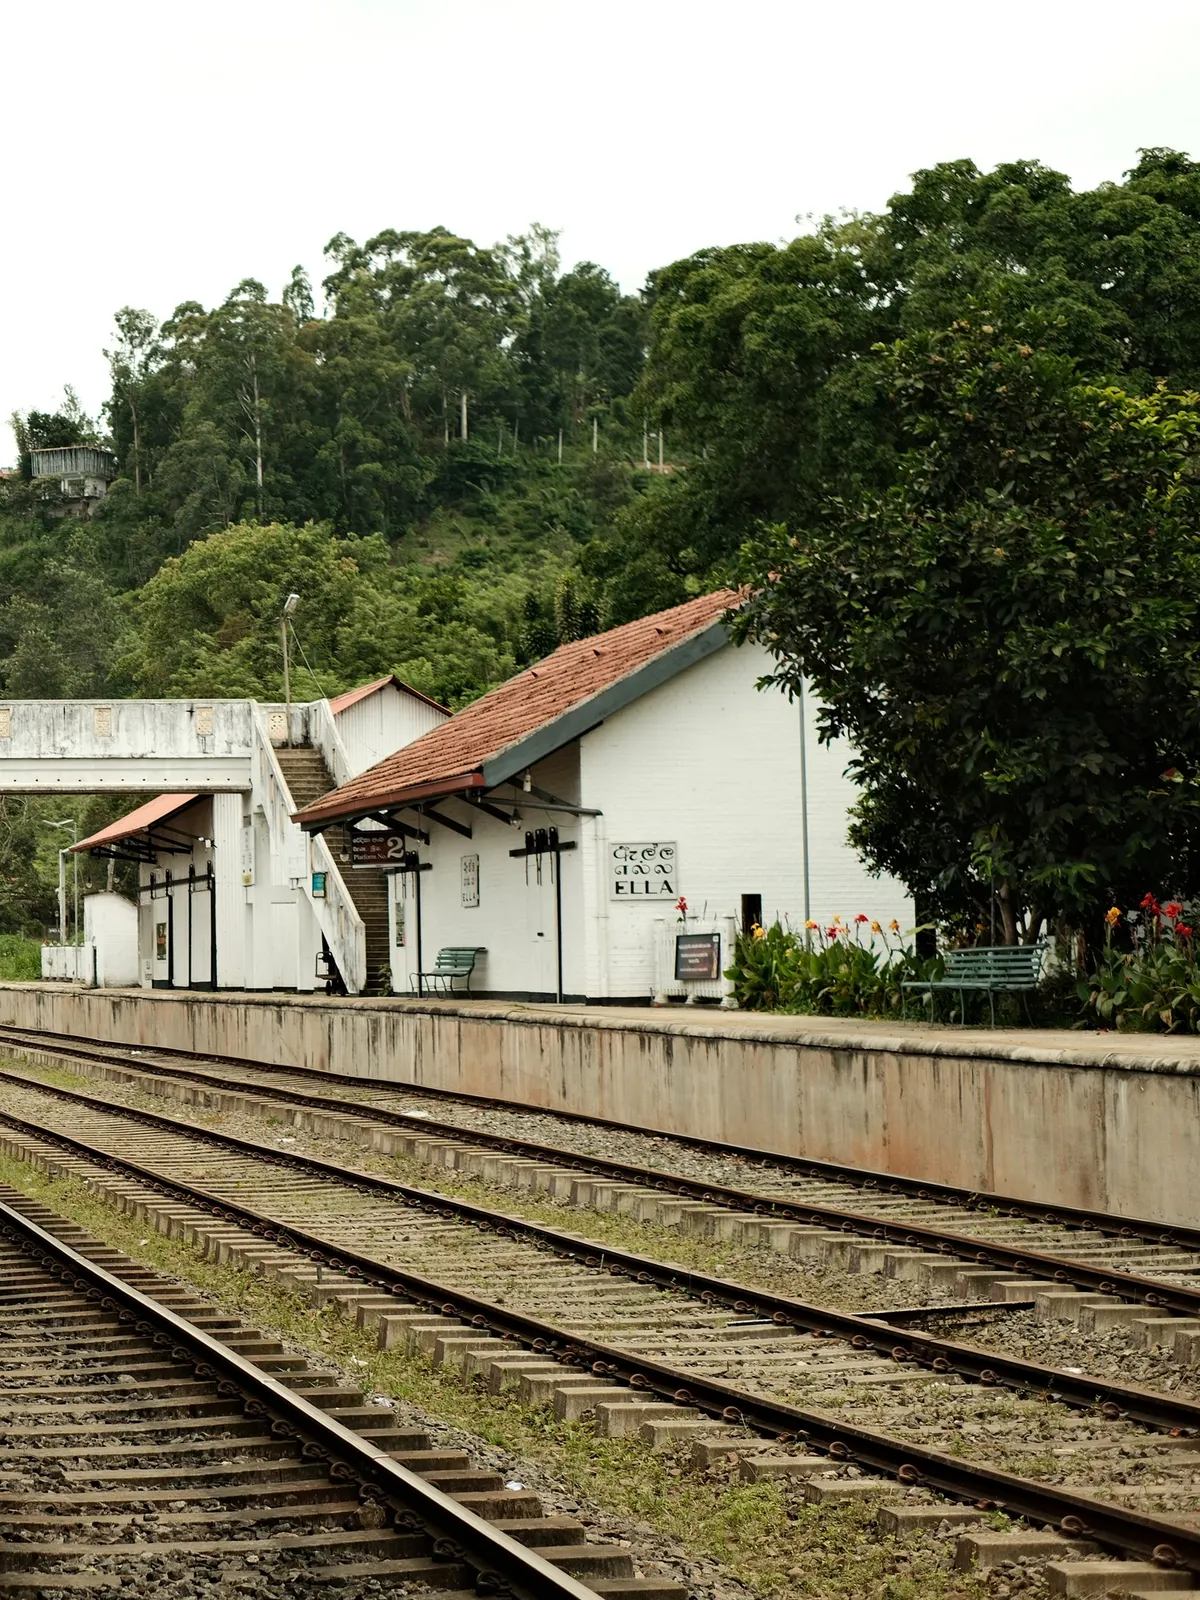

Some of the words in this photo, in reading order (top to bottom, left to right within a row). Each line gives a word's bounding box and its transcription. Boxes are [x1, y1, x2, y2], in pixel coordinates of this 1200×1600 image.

[387, 836, 404, 858] 2
[613, 843, 674, 861] ඇල්ල
[615, 860, 673, 875] எல்ல
[615, 880, 674, 894] ELLA
